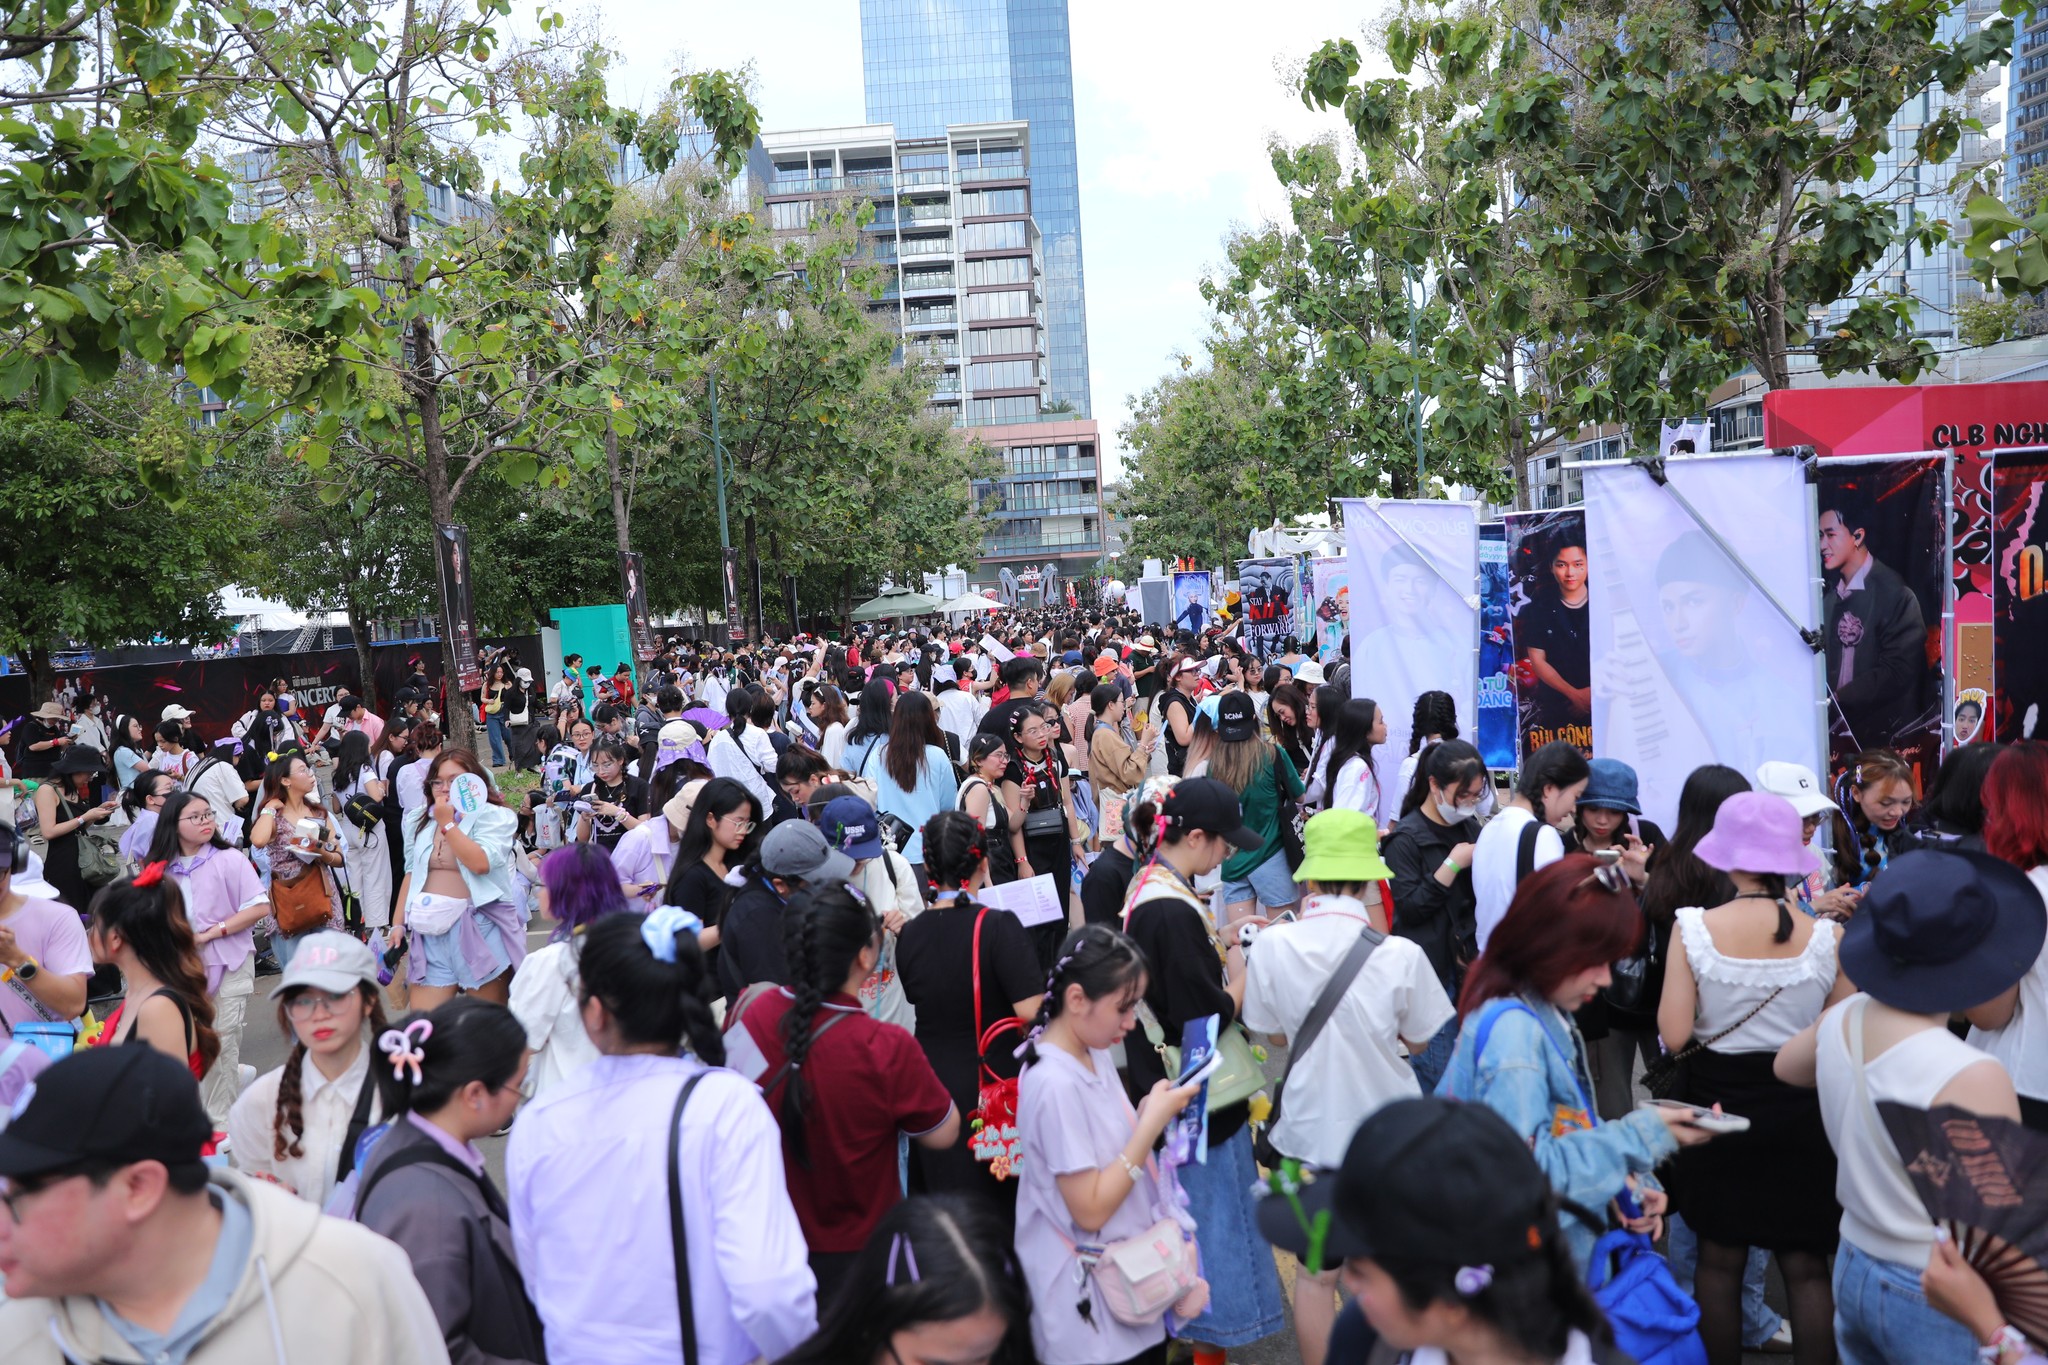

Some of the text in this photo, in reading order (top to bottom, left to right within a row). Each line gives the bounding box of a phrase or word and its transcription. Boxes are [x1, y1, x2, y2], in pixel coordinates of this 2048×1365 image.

[1932, 424, 1987, 448] CLB
[1250, 597, 1263, 606] STAY
[1250, 622, 1292, 637] FORWARD
[1798, 778, 1809, 788] C
